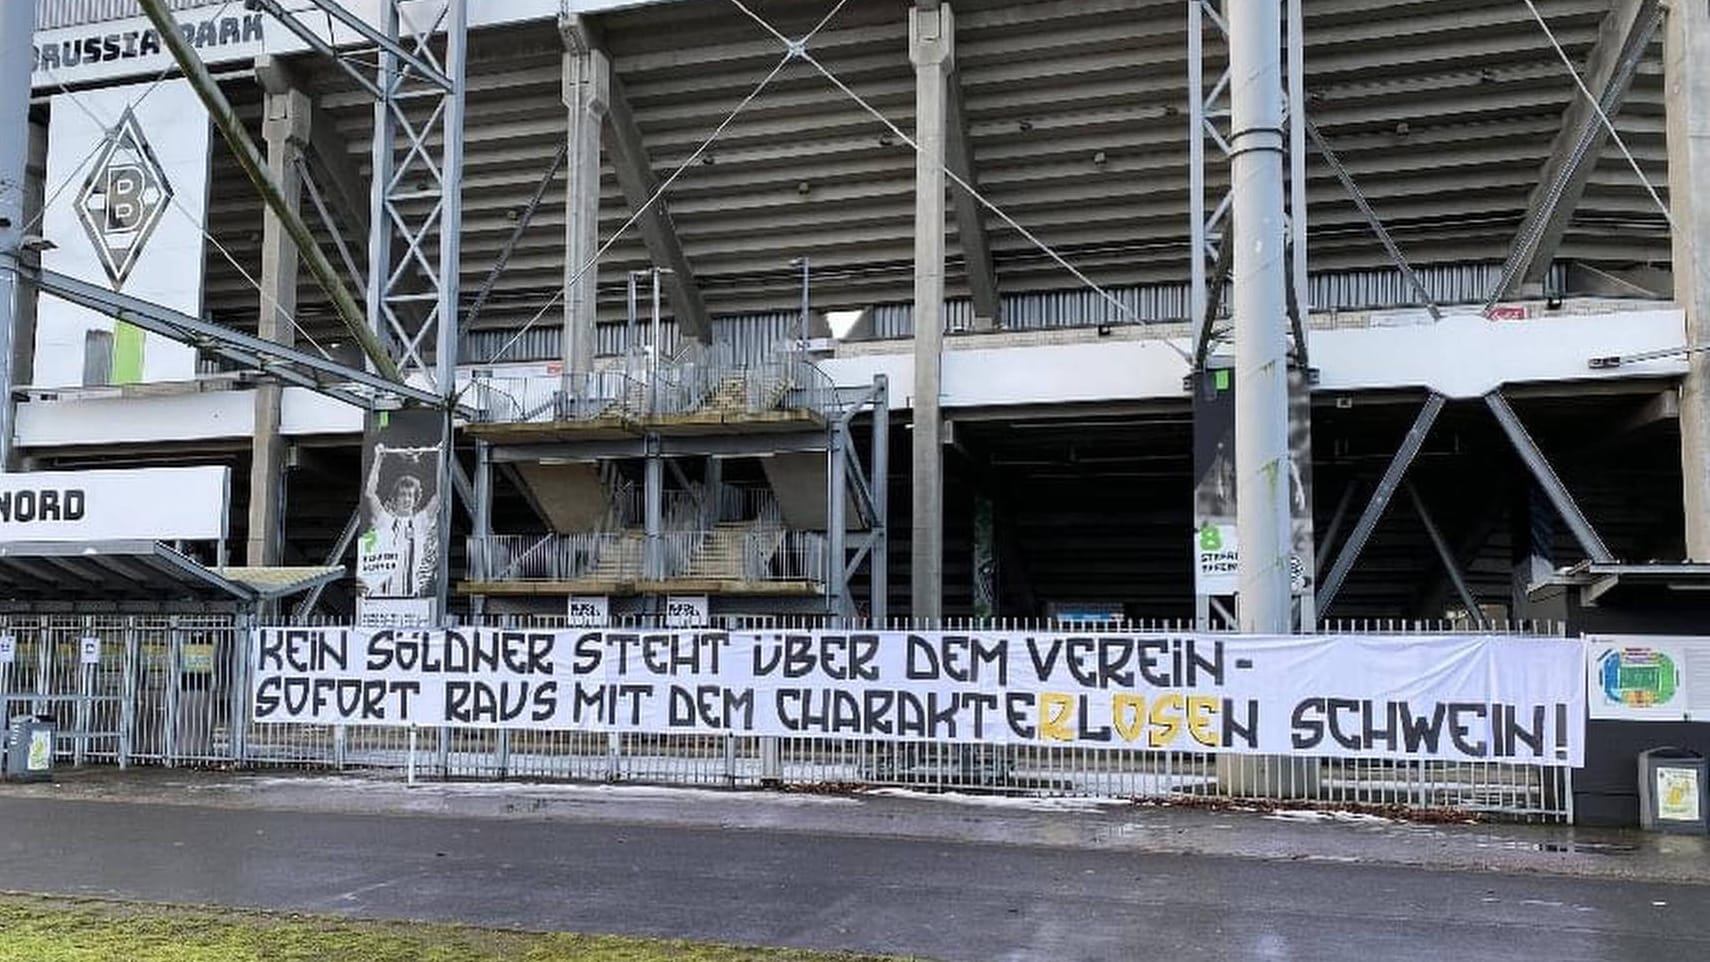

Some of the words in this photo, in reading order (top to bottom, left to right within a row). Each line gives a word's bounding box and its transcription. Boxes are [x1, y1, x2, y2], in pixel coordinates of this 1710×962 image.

[366, 630, 555, 675] SÖLDNER
[572, 632, 730, 675] STEHT
[753, 634, 880, 681] ÜBER
[906, 634, 1008, 687] DEM
[255, 675, 420, 720] SOFORT
[445, 680, 557, 723] RAUS
[573, 681, 653, 726] MIT
[669, 684, 754, 730] DEM
[776, 688, 1258, 748] CHARAKTERLOSEN
[1290, 697, 1568, 760] SCHWEIN!
